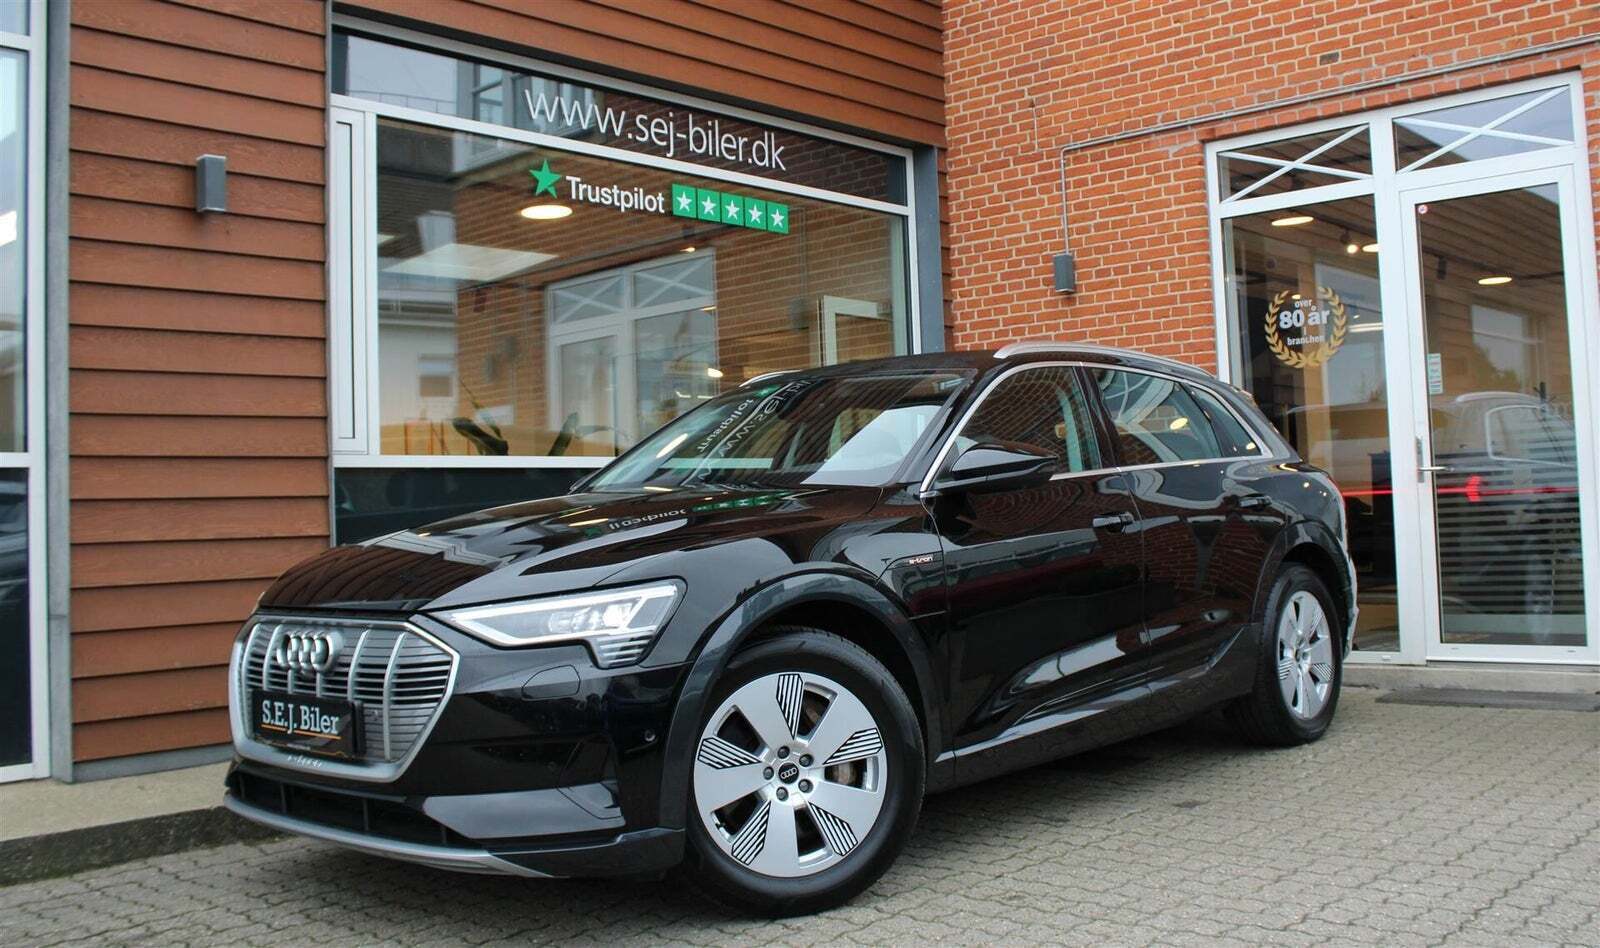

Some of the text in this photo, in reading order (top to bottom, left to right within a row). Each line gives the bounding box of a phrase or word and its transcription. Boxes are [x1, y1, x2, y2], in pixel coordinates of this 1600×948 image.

[525, 90, 786, 170] www.sej-biler.dk
[566, 176, 665, 213] Trustpilot
[1279, 305, 1331, 329] 80 år
[262, 700, 339, 735] S.E.J. Biler
